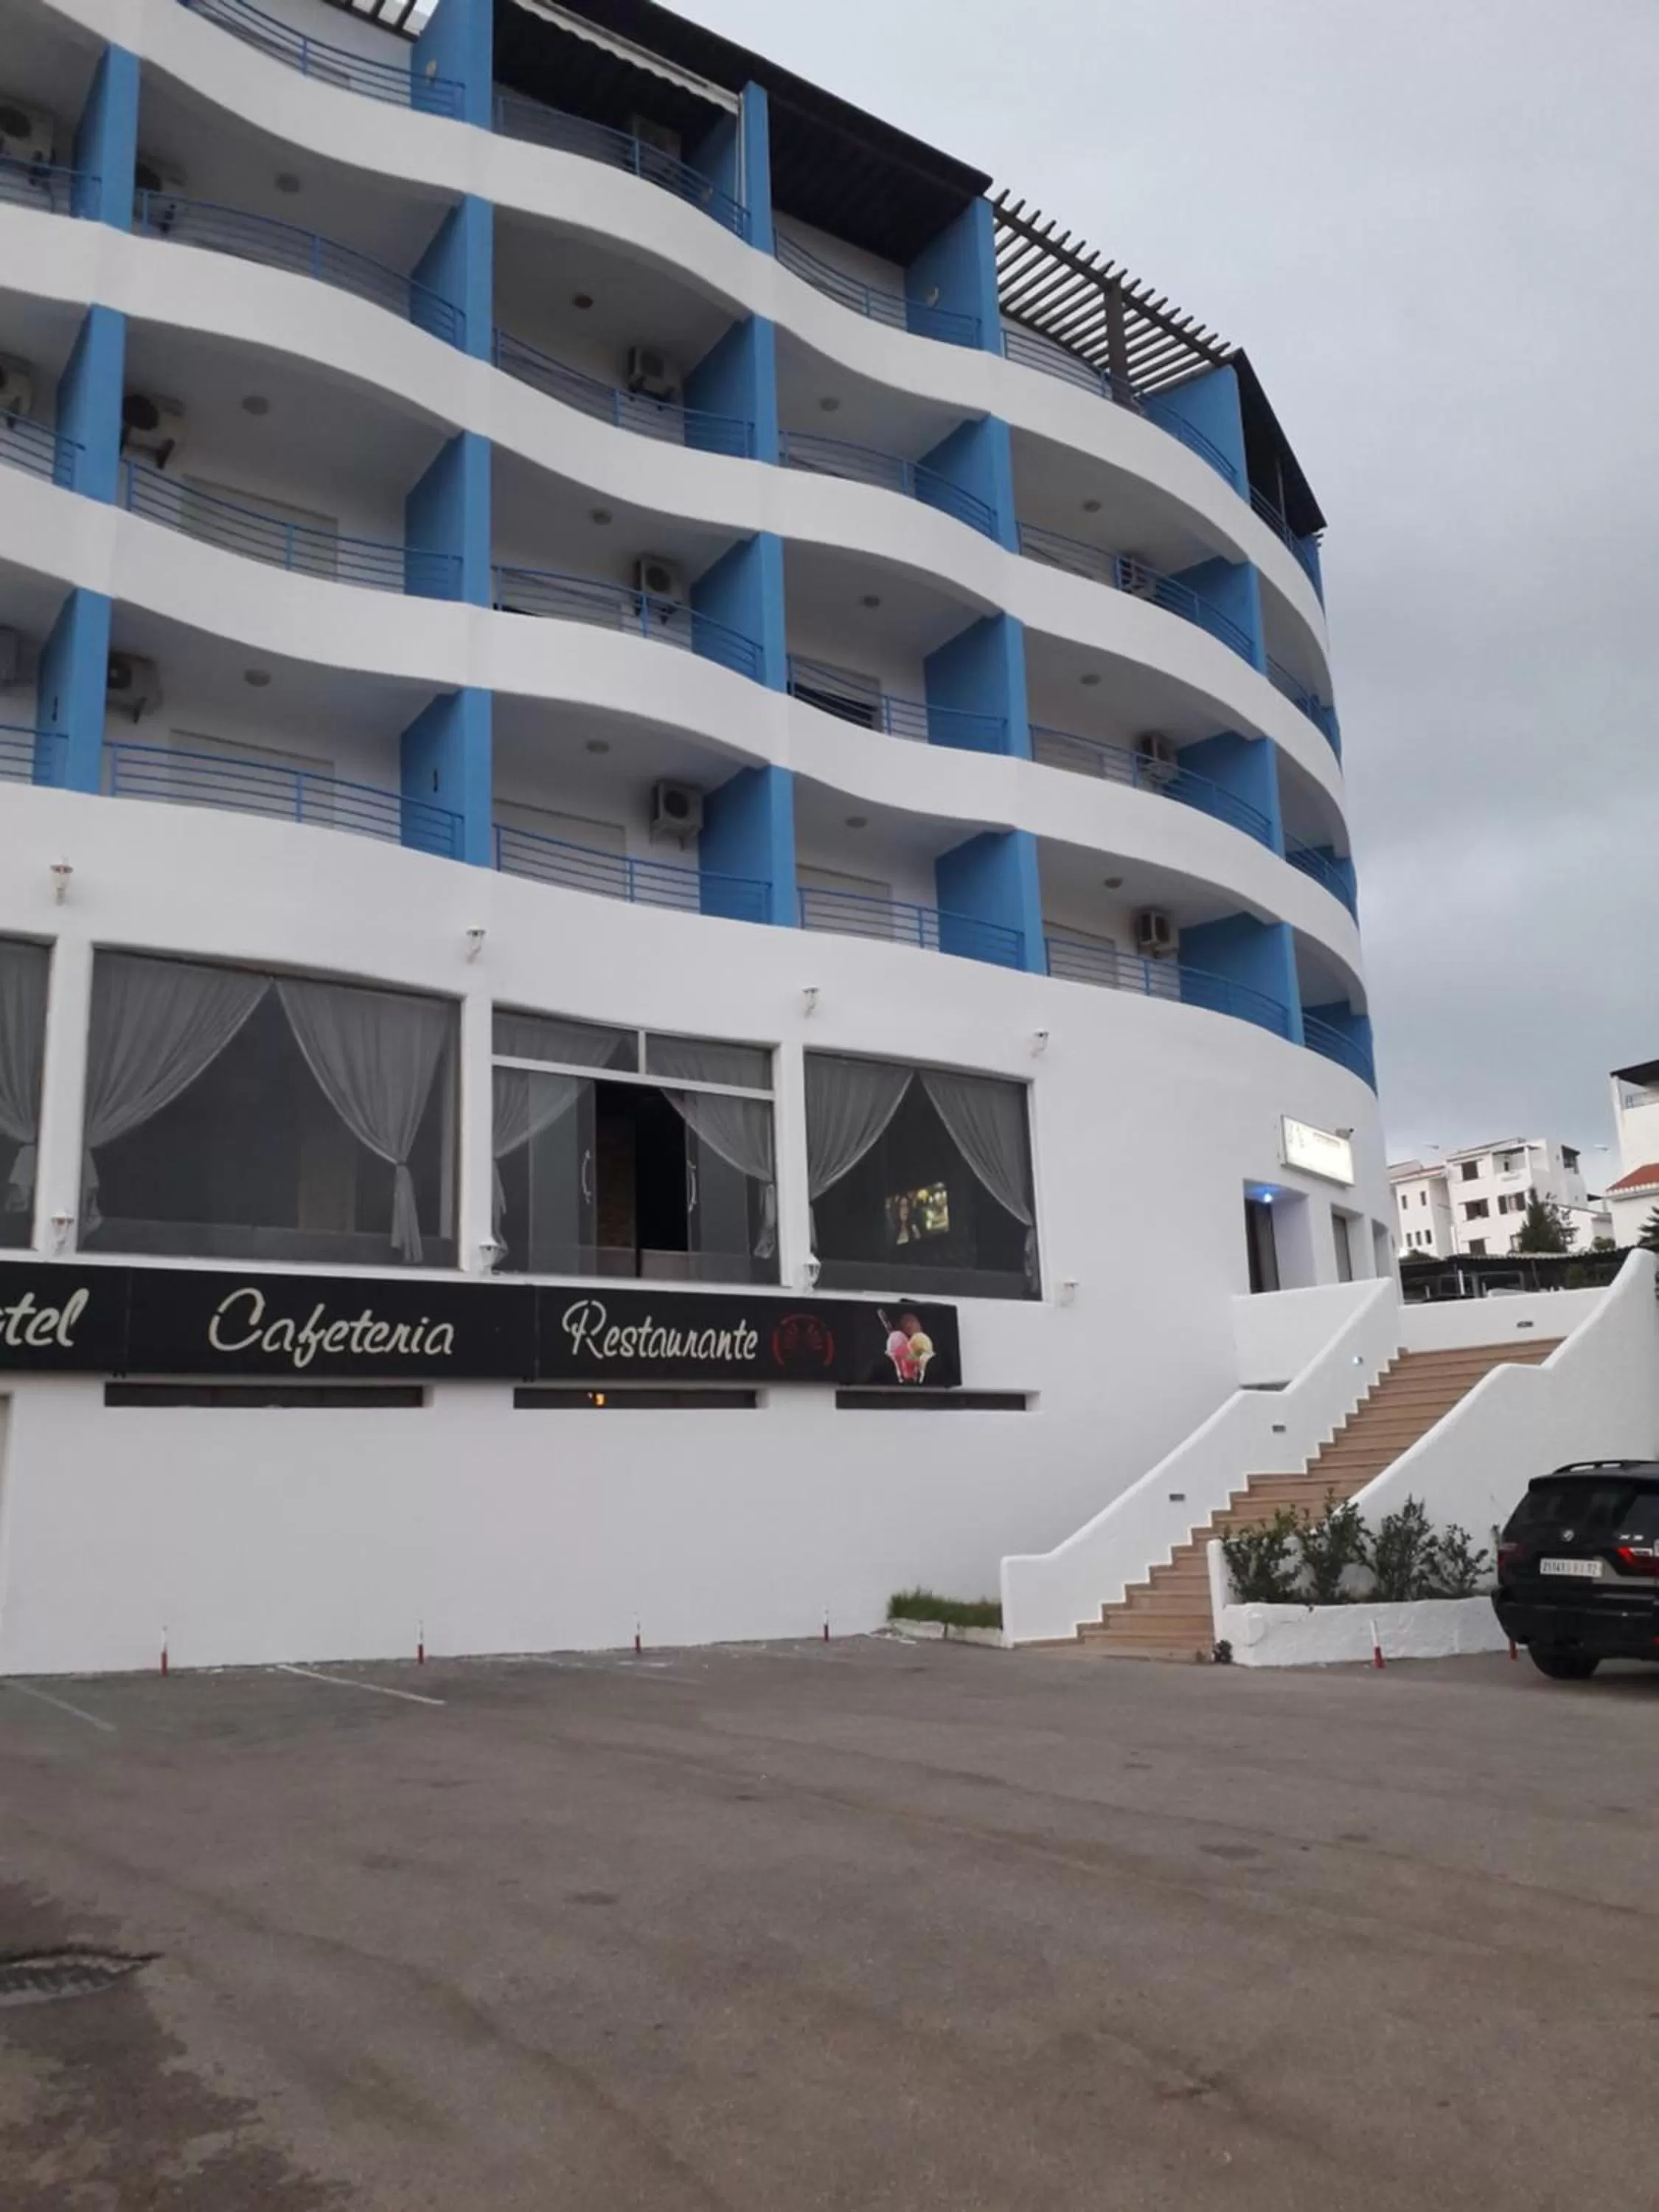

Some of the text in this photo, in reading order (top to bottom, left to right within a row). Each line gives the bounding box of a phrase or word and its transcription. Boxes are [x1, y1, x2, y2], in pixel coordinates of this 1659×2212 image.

[0, 1287, 758, 1368] tel Cafeteria Restaurante
